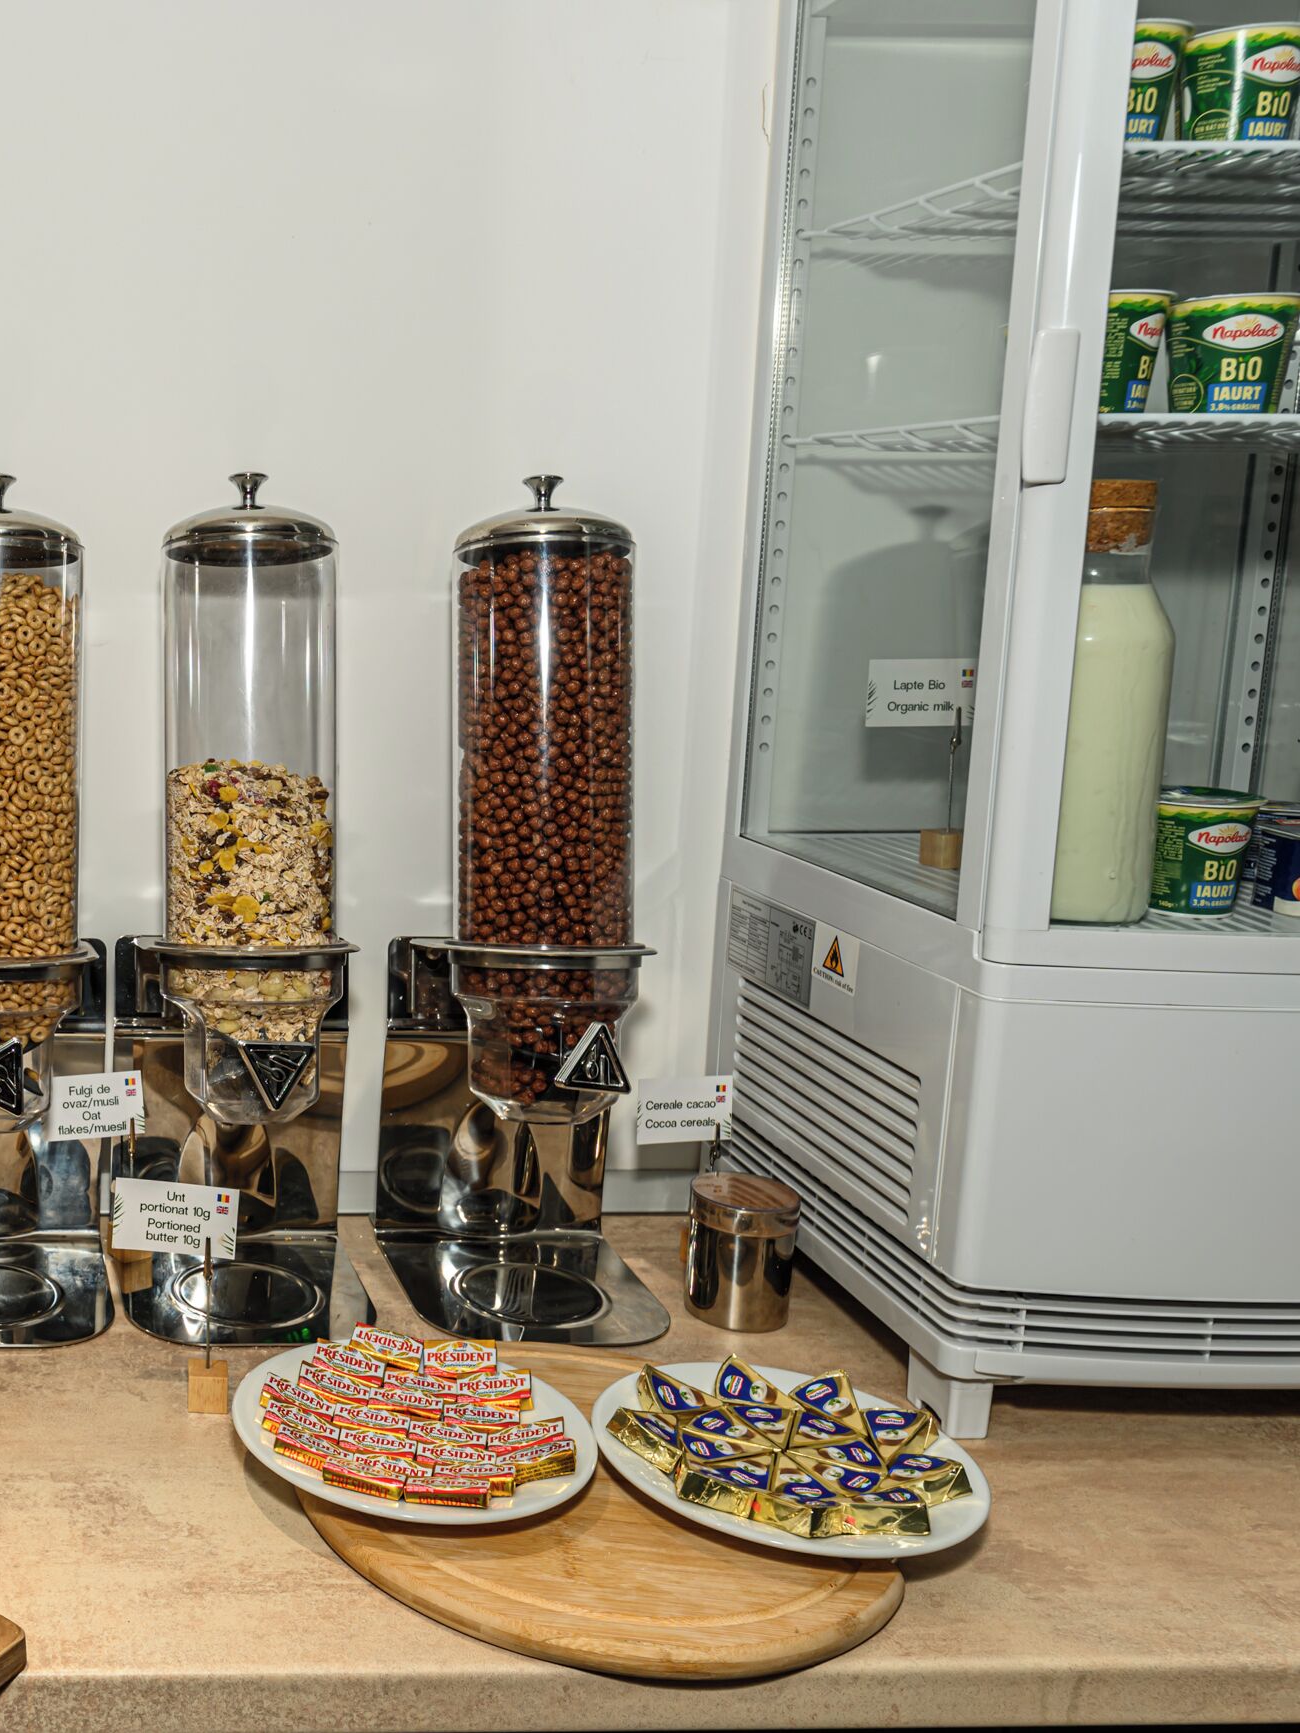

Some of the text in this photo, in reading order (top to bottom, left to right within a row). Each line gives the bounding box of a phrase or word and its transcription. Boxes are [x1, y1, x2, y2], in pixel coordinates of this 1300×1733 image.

[1132, 52, 1173, 70] polact
[1128, 119, 1156, 134] URT
[1248, 121, 1287, 137] IAURT
[1212, 324, 1281, 341] Napolact
[1213, 386, 1262, 401] IAURT
[893, 680, 946, 692] Lapte Bio
[887, 701, 954, 714] Organic milk
[1198, 830, 1250, 846] Napolact
[1196, 884, 1234, 898] IAURT
[68, 1084, 111, 1098] Fulgi de
[62, 1096, 120, 1109] ovaz/musli
[645, 1100, 717, 1111] Cereale cacao
[82, 1111, 101, 1121] Oat
[645, 1117, 716, 1129] Cocoa cereals
[58, 1121, 127, 1135] flakes/muesli
[167, 1191, 185, 1202] Unt
[140, 1203, 211, 1221] portionat 10g
[147, 1218, 201, 1233] Portioned
[146, 1230, 201, 1249] butter 10g
[427, 1350, 492, 1363] PRÉSIDENT
[459, 1377, 526, 1391] PRÉSIDENT
